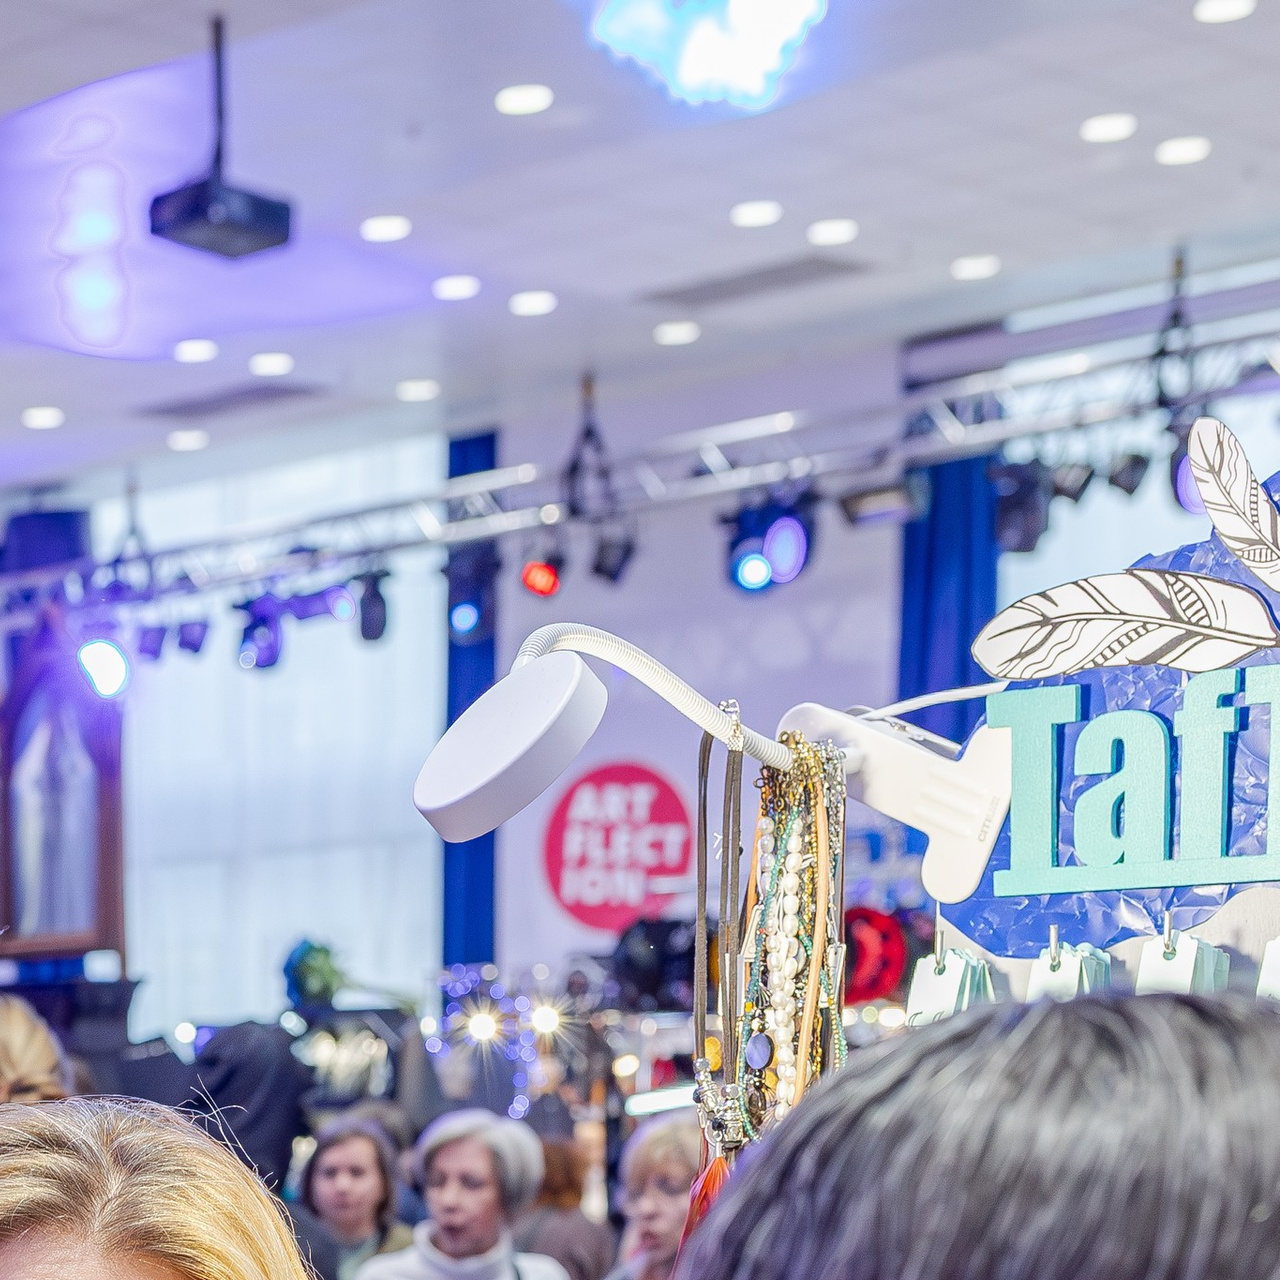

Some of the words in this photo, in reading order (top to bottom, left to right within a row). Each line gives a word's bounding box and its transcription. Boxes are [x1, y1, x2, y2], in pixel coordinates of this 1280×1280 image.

[569, 781, 657, 821] ART
[562, 822, 689, 868] FLECT
[560, 867, 646, 909] ION
